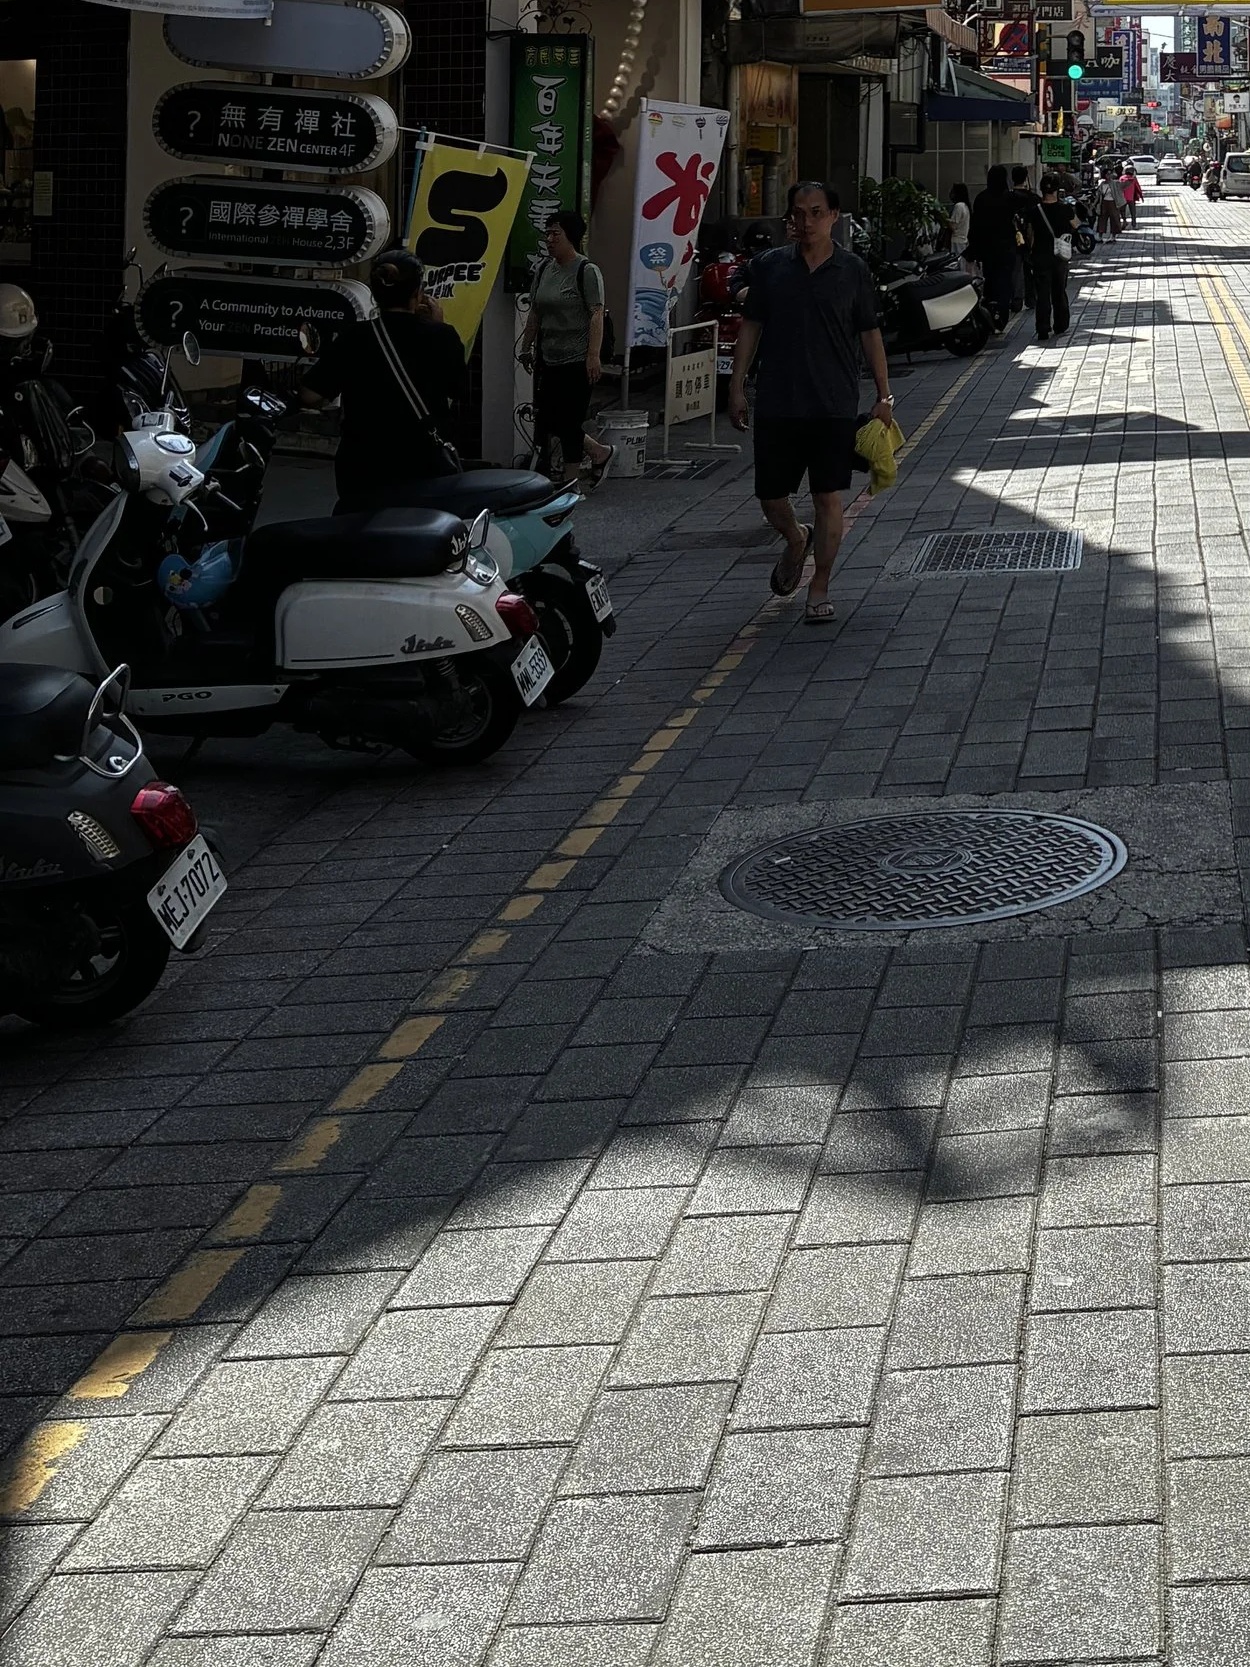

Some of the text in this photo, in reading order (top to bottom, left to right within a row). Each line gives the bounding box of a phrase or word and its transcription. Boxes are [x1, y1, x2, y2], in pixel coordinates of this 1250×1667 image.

[219, 102, 356, 138] 無有禪社
[266, 136, 298, 153] ZEN
[299, 143, 338, 157] CENTER
[338, 143, 356, 157] 4F
[208, 200, 353, 234] 國際參禪學舍
[208, 231, 269, 245] International
[292, 236, 323, 248] House
[200, 298, 345, 320] A Community to Advance
[199, 319, 225, 332] Your
[253, 323, 299, 338] Practice
[161, 690, 212, 703] PGO
